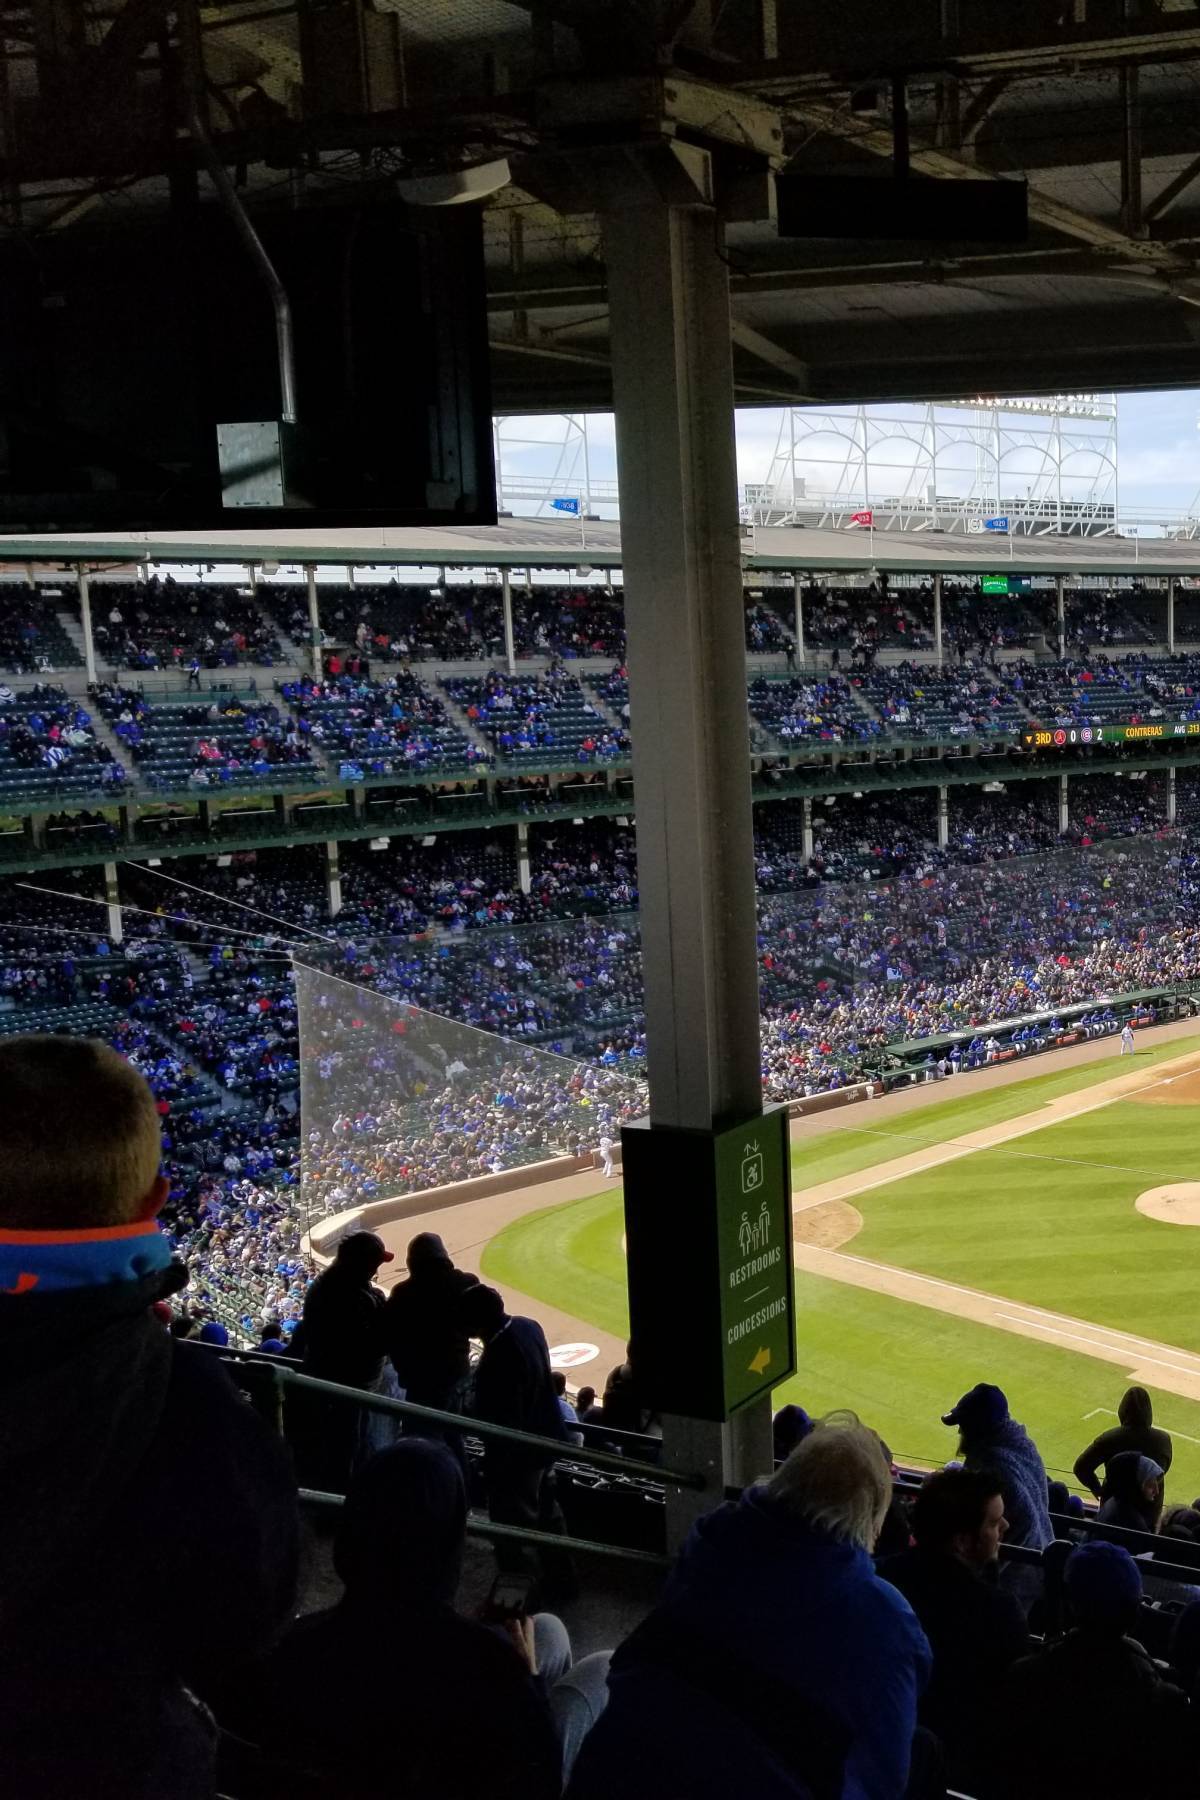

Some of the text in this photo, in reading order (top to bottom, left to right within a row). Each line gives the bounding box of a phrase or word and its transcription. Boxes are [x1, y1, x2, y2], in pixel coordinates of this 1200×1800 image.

[1035, 732, 1051, 745] 3RD
[1070, 731, 1076, 742] 0
[1097, 729, 1103, 741] 2
[1125, 726, 1163, 738] CONTRERAS
[1174, 725, 1186, 734] AVG
[1188, 724, 1200, 734] .313
[729, 1246, 781, 1289] RESTROOMS
[727, 1296, 787, 1345] CONCESSIONS
